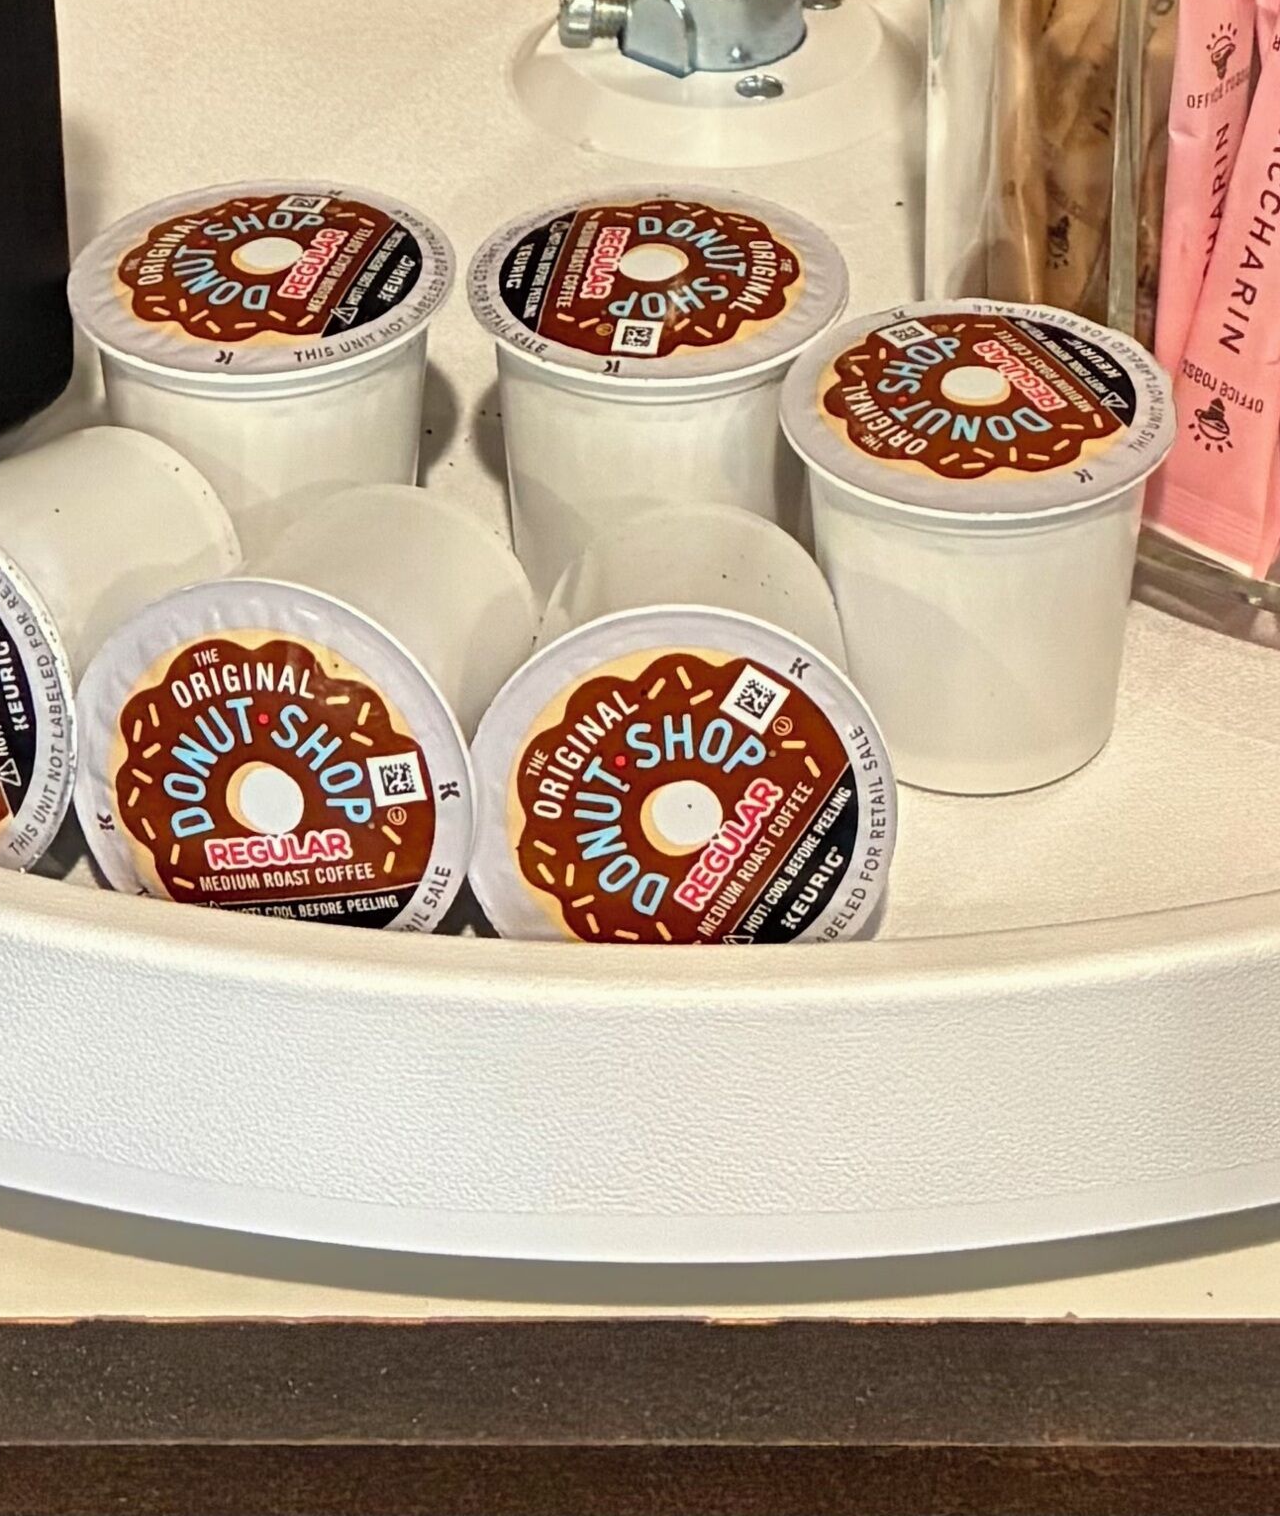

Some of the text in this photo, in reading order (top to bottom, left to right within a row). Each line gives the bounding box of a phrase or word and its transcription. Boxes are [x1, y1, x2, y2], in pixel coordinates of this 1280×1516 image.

[137, 218, 209, 286] ORIGINAL
[172, 211, 325, 311] DONUT SHOP
[277, 228, 350, 299] REGULAR
[506, 242, 535, 290] KEURIG
[580, 226, 631, 299] REGULAR
[608, 216, 747, 318] DONUT SHOP
[377, 255, 417, 302] KEURIG
[728, 241, 778, 314] ORIGINAL
[294, 348, 334, 363] THIS
[340, 331, 377, 353] UNIT
[380, 316, 408, 334] NOT
[510, 331, 548, 354] SALE
[1062, 338, 1122, 379] KEURIG
[877, 337, 1054, 443] DONUT SHOP
[972, 339, 1069, 412] REGULAR
[1146, 384, 1166, 405] NOT
[842, 380, 928, 455] ORIGINAL
[1150, 406, 1166, 430] UNIT
[859, 433, 883, 452] THE
[1129, 430, 1156, 453] THIS
[17, 612, 43, 648] FOR
[193, 648, 220, 667] THE
[37, 655, 65, 739] LABELED
[171, 662, 315, 709] ORIGINAL
[47, 744, 65, 781] NOT
[163, 697, 372, 838] DONUT SHOP
[525, 749, 549, 777] THE
[532, 690, 639, 819] ORIGINAL
[849, 726, 878, 772] SALE
[33, 785, 57, 823] UNIT
[573, 713, 767, 916] DONUT SHOP
[868, 776, 887, 839] RETAIL
[8, 824, 39, 856] THIS
[204, 828, 353, 871] REGULAR
[673, 778, 784, 912] REGULAR
[697, 780, 814, 937] MEDIUM ROAST COFFEE
[743, 786, 852, 934] HOT! COOL BEFORE PEELING
[199, 862, 376, 892] MEDIUM ROAST COFFEE
[424, 866, 451, 909] SALE
[860, 847, 883, 882] FOR
[298, 901, 345, 918] BEFORE
[347, 895, 399, 913] PEELING
[781, 850, 844, 931] KEURIG
